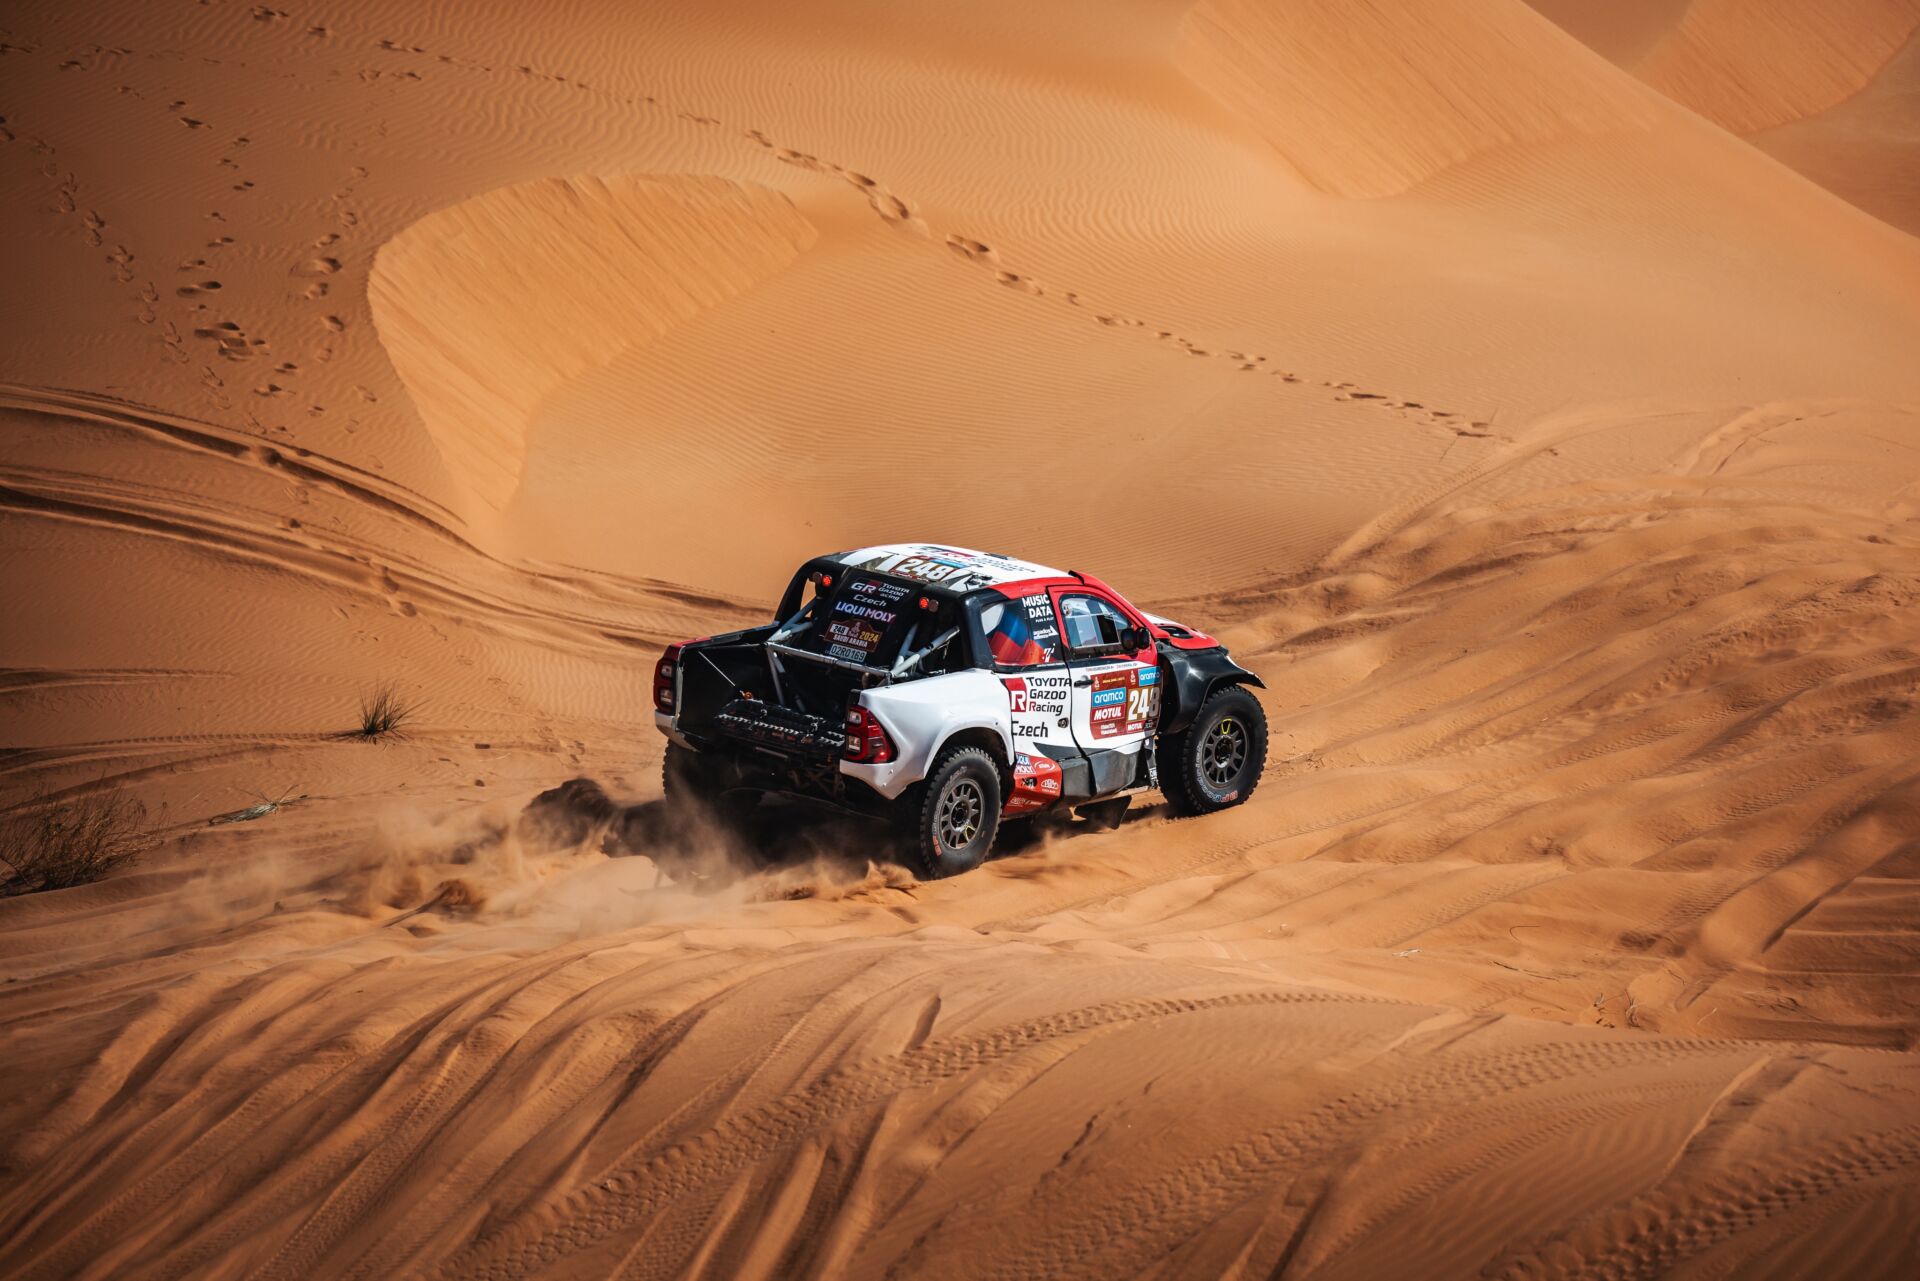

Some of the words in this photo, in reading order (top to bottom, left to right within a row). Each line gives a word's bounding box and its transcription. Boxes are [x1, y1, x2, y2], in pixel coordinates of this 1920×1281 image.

[898, 558, 949, 580] 248
[851, 582, 876, 593] GR
[878, 587, 904, 597] GAZOO
[881, 583, 910, 593] TOYOTA
[853, 594, 887, 607] Czech
[1022, 594, 1050, 608] MUSIC
[835, 601, 865, 615] LIQUI
[864, 608, 896, 622] MOLY
[1028, 606, 1053, 618] DATA
[833, 625, 845, 633] 248
[833, 634, 849, 643] SAUDI
[848, 637, 868, 647] ARABIA
[859, 631, 880, 643] 2024
[1026, 677, 1072, 687] TOYOTA
[1029, 689, 1067, 700] GAZOO
[1094, 691, 1124, 704] aramco
[1028, 701, 1064, 716] Racing
[1128, 687, 1160, 720] 248
[1094, 706, 1122, 721] MOTUL
[1127, 722, 1142, 731] MOTUL
